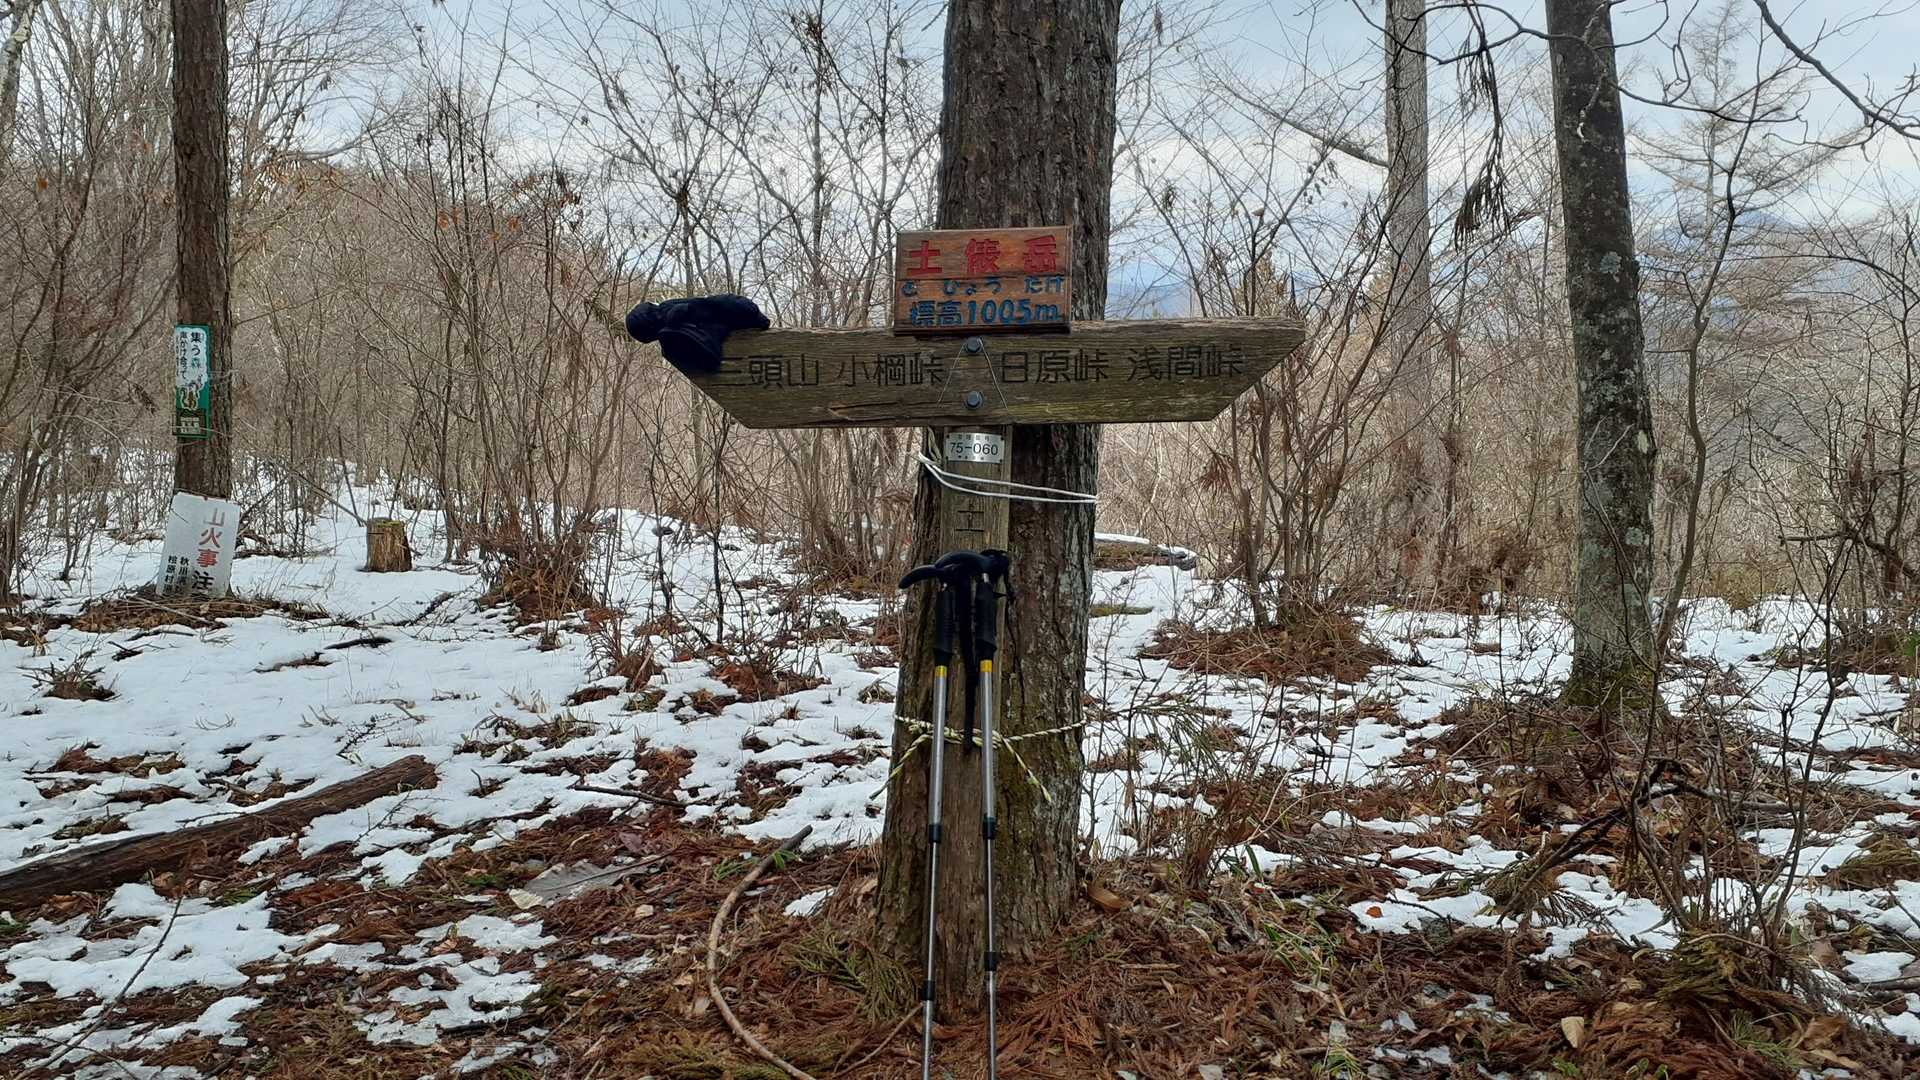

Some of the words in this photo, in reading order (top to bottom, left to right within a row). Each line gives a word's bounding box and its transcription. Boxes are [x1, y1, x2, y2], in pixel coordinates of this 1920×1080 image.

[906, 234, 1059, 276] 土俵岳
[909, 298, 1063, 327] 標高1005m
[1001, 348, 1109, 384] 日原峠
[1127, 343, 1244, 383] 浅間峠
[950, 442, 999, 456] 75-060
